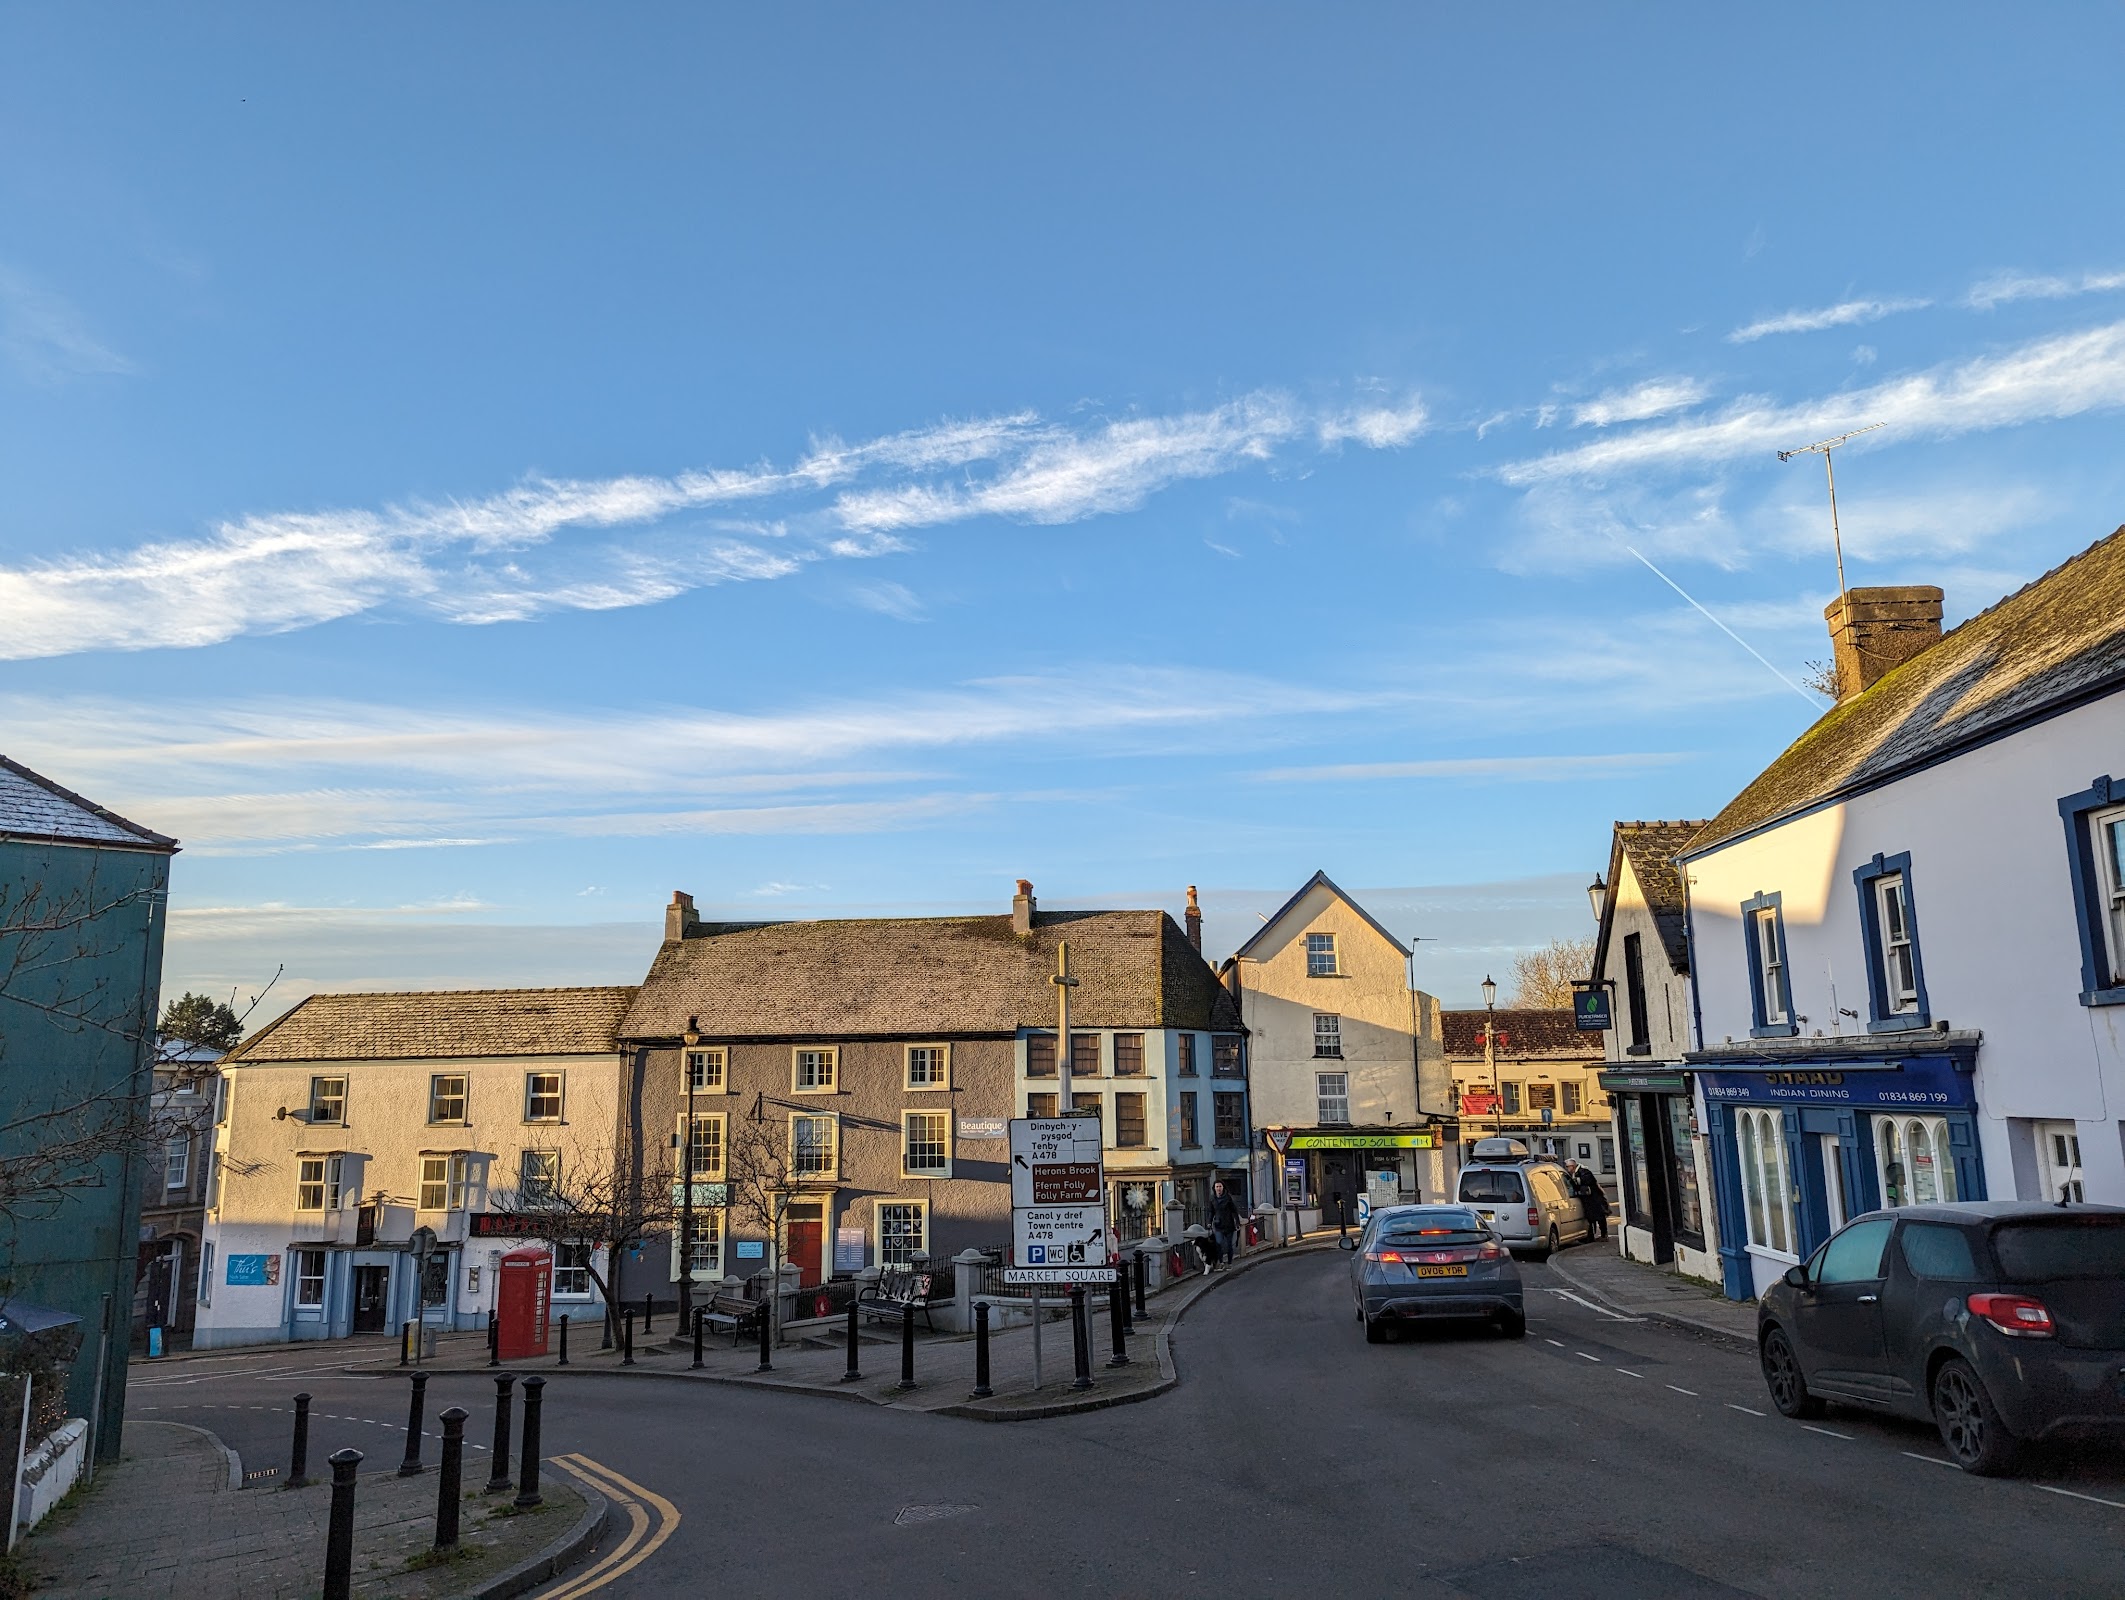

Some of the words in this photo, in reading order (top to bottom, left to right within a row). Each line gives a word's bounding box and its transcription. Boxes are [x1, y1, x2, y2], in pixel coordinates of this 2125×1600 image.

[1707, 1087, 1726, 1096] 01834
[1726, 1087, 1738, 1097] 869
[1769, 1088, 1806, 1097] INDIAN
[1809, 1089, 1850, 1098] DINING
[1878, 1091, 1908, 1101] 01834
[1908, 1092, 1927, 1102] 869
[1928, 1092, 1948, 1102] 199
[960, 1120, 1003, 1132] Beautique
[1528, 1124, 1549, 1132] INN
[1041, 1131, 1072, 1141] pysgod
[1031, 1141, 1059, 1150] Tenby
[1305, 1137, 1367, 1148] CONTENTED
[1368, 1137, 1398, 1147] SOLE
[1031, 1151, 1057, 1160] A478
[1034, 1167, 1067, 1176] Herons
[1069, 1166, 1096, 1175] Brook
[1035, 1181, 1061, 1190] Fferm
[1063, 1180, 1086, 1190] Folly
[1035, 1191, 1057, 1201] Folly
[1060, 1190, 1082, 1199] Farm
[1027, 1211, 1054, 1220] Canol
[1056, 1213, 1062, 1221] y
[1064, 1211, 1083, 1220] dref
[1027, 1221, 1052, 1230] Town
[1054, 1221, 1084, 1230] centre
[1028, 1231, 1054, 1240] A478
[1032, 1247, 1043, 1262] P
[1049, 1249, 1063, 1259] WC
[1008, 1270, 1059, 1282] MARKET
[1065, 1270, 1114, 1281] SQUARE
[1420, 1266, 1444, 1276] OV06
[1446, 1266, 1463, 1275] YDR
